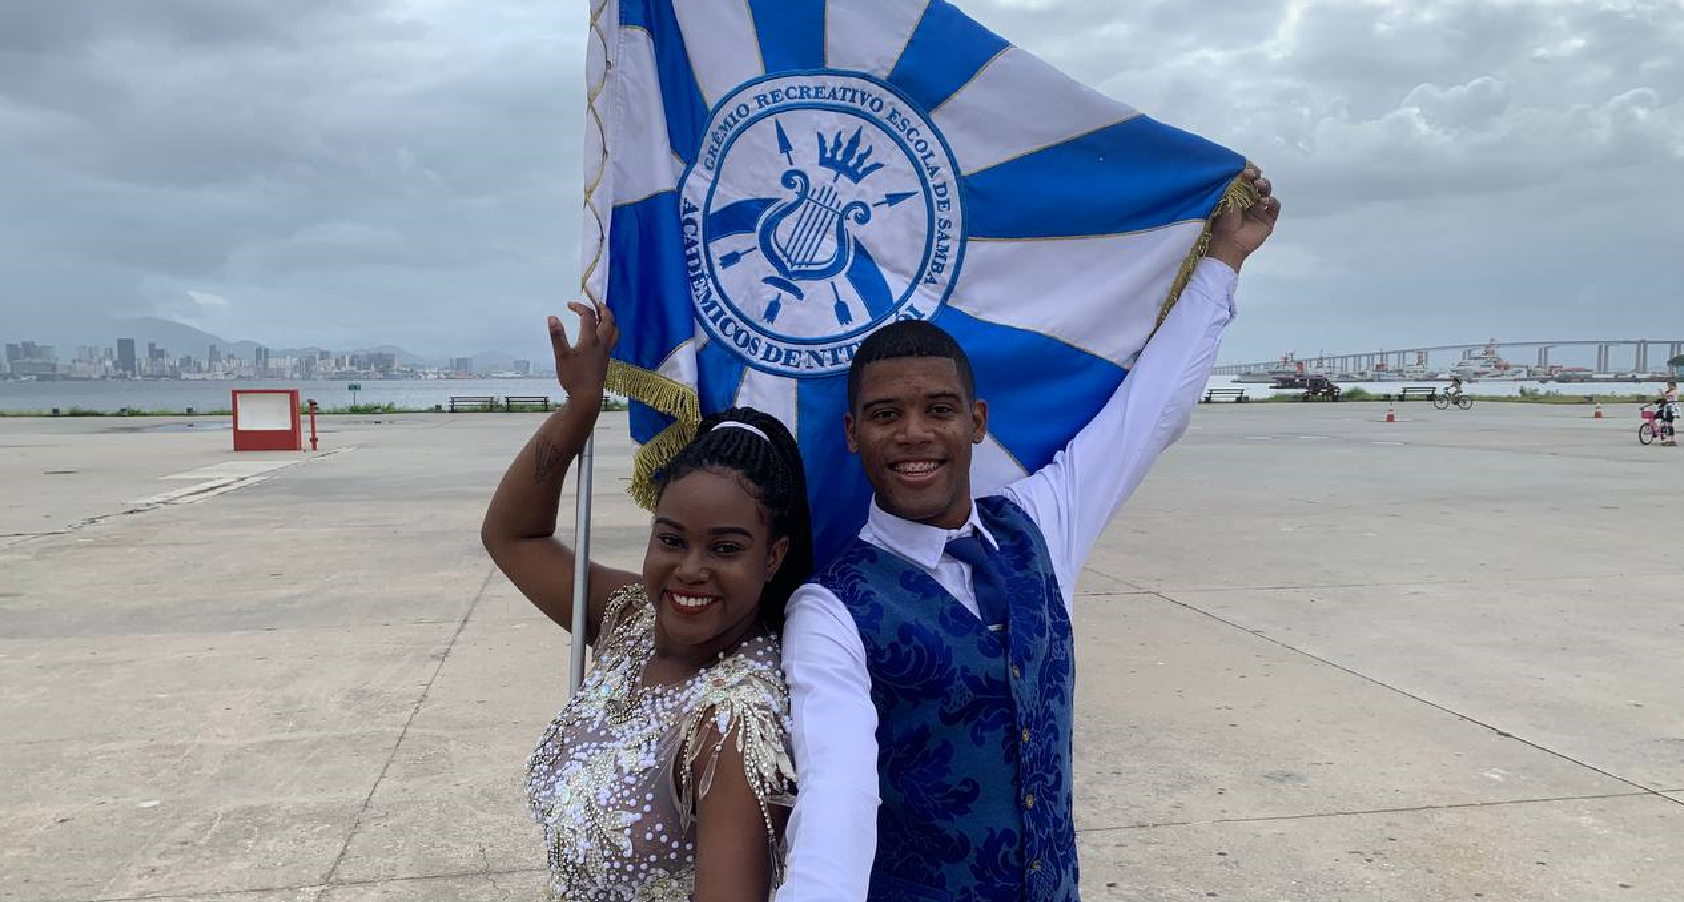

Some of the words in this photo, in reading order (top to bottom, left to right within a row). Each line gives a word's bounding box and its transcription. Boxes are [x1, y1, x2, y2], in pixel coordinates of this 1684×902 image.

[754, 85, 884, 112] RECREATIVO
[887, 107, 940, 178] ESCOLA
[932, 182, 950, 212] DE
[924, 218, 952, 285] SAMBA
[760, 342, 800, 368] DE
